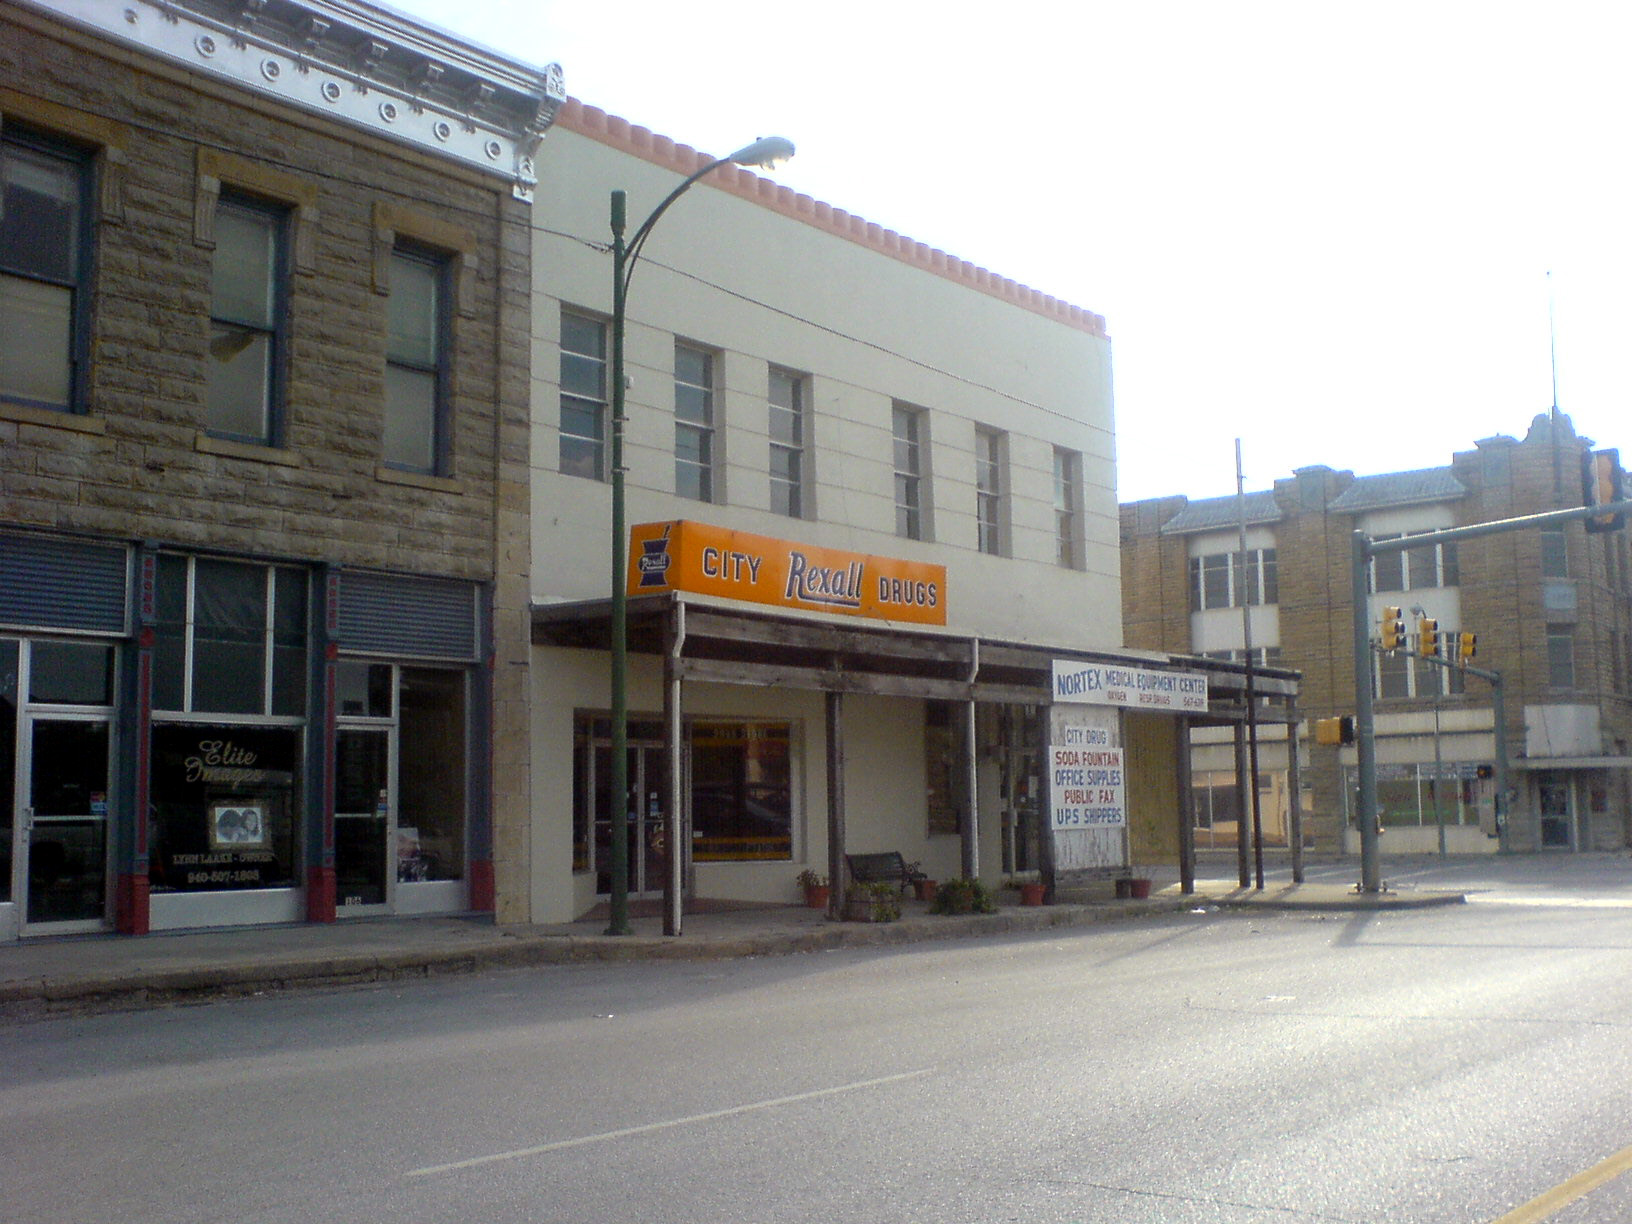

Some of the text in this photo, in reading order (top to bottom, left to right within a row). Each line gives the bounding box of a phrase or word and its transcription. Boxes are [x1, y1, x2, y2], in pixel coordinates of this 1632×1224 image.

[702, 546, 937, 608] CITY Rexall DRUGS
[1057, 669, 1205, 695] NORTEX MEDICAL EQUIPMENT CENTER
[1066, 729, 1107, 745] CITY DRUG
[198, 740, 258, 766] Elite
[1055, 751, 1120, 766] SODA FOUNTAIN
[1055, 770, 1121, 786] OFFICE SUPPLIES
[1064, 790, 1115, 804] PUBLIC FAX
[1056, 807, 1122, 825] UPS SHIPPERS
